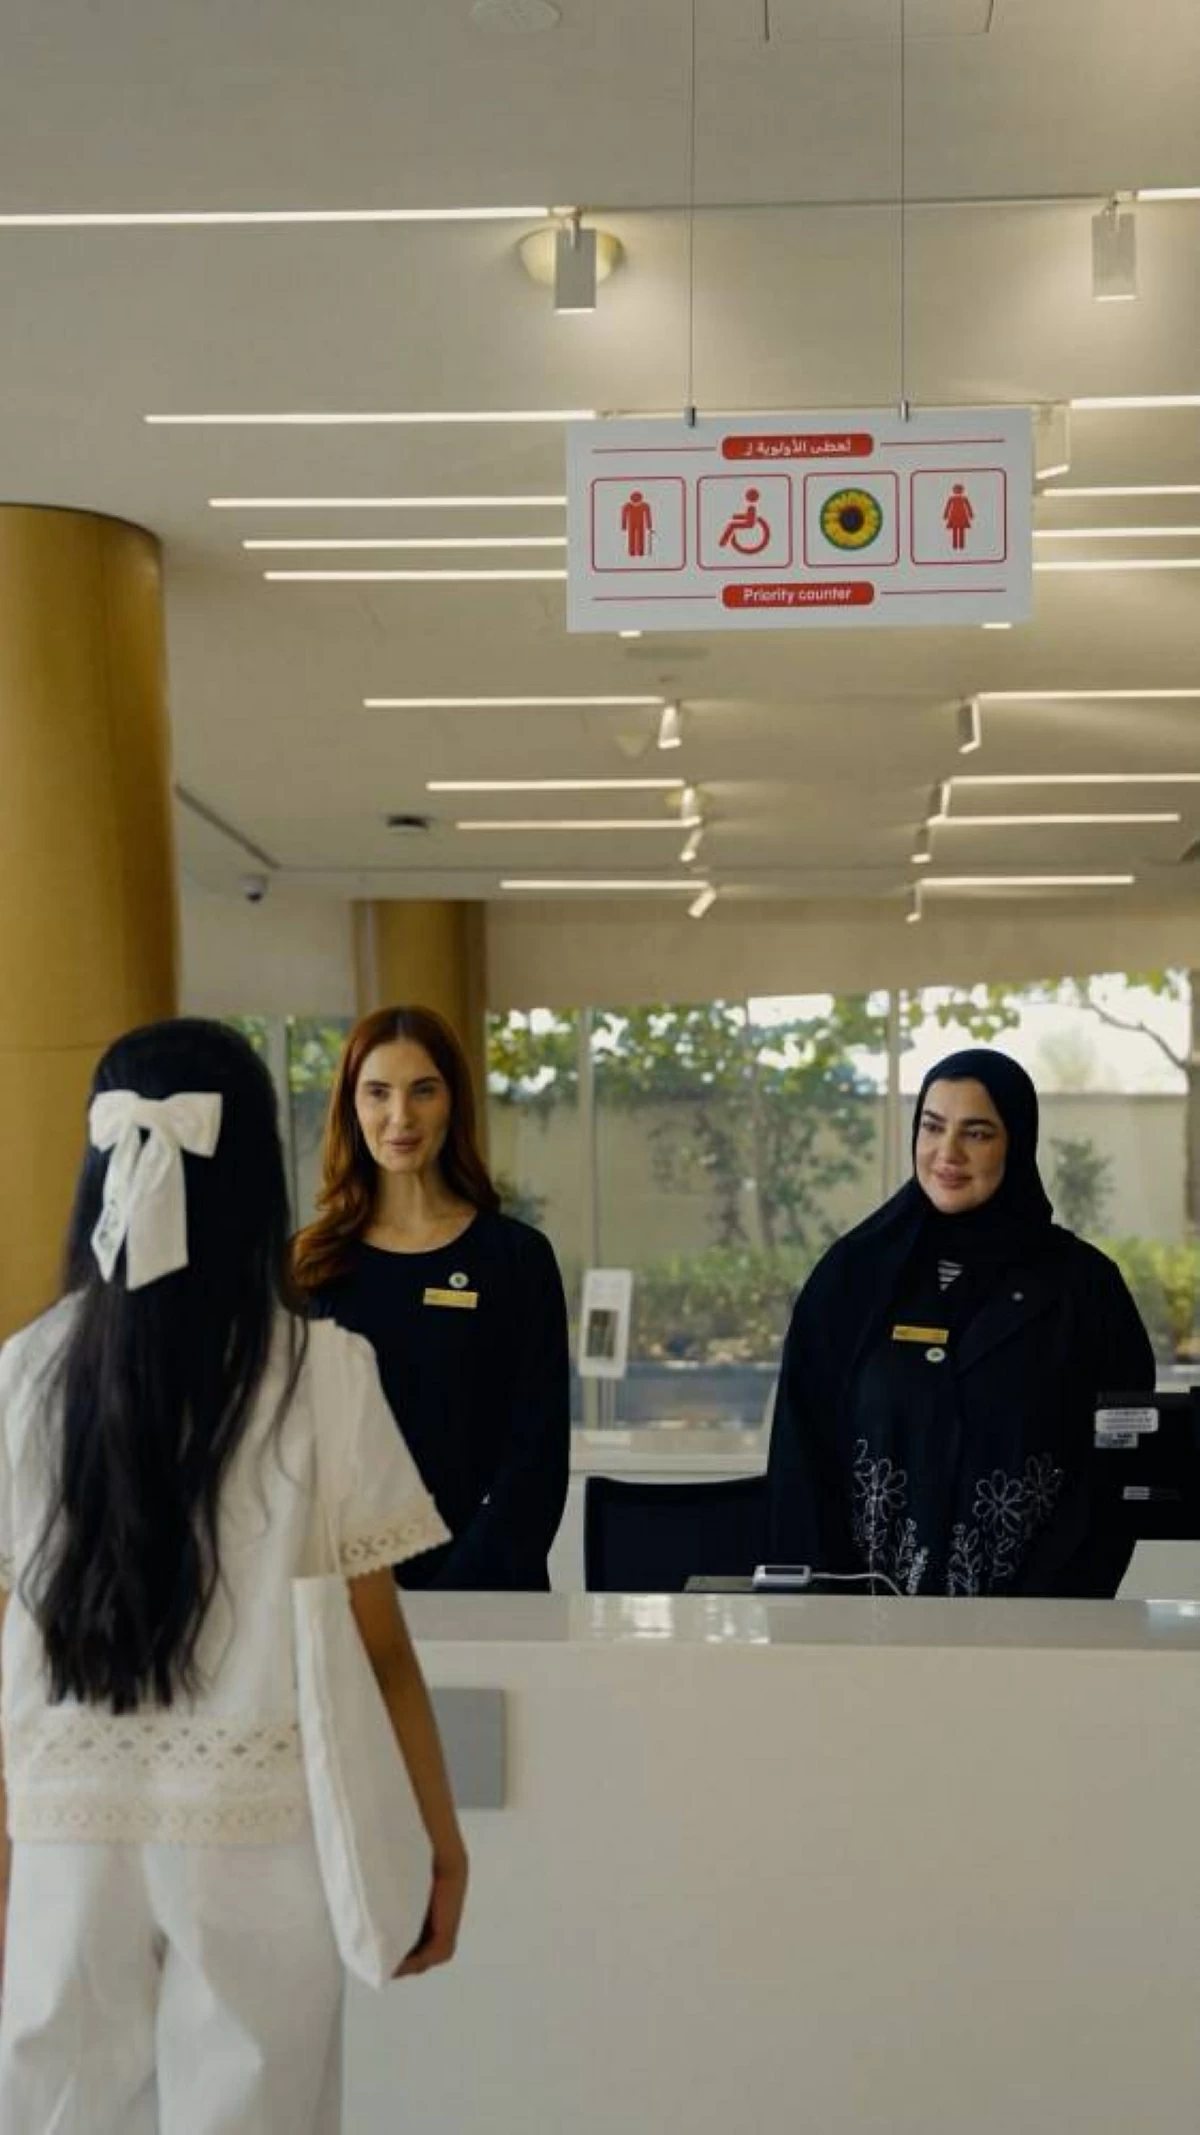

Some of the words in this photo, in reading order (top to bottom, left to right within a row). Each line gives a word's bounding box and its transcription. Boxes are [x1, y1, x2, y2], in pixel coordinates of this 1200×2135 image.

[757, 438, 807, 456] الأولوية
[743, 587, 794, 605] Priority
[799, 588, 851, 602] counter
